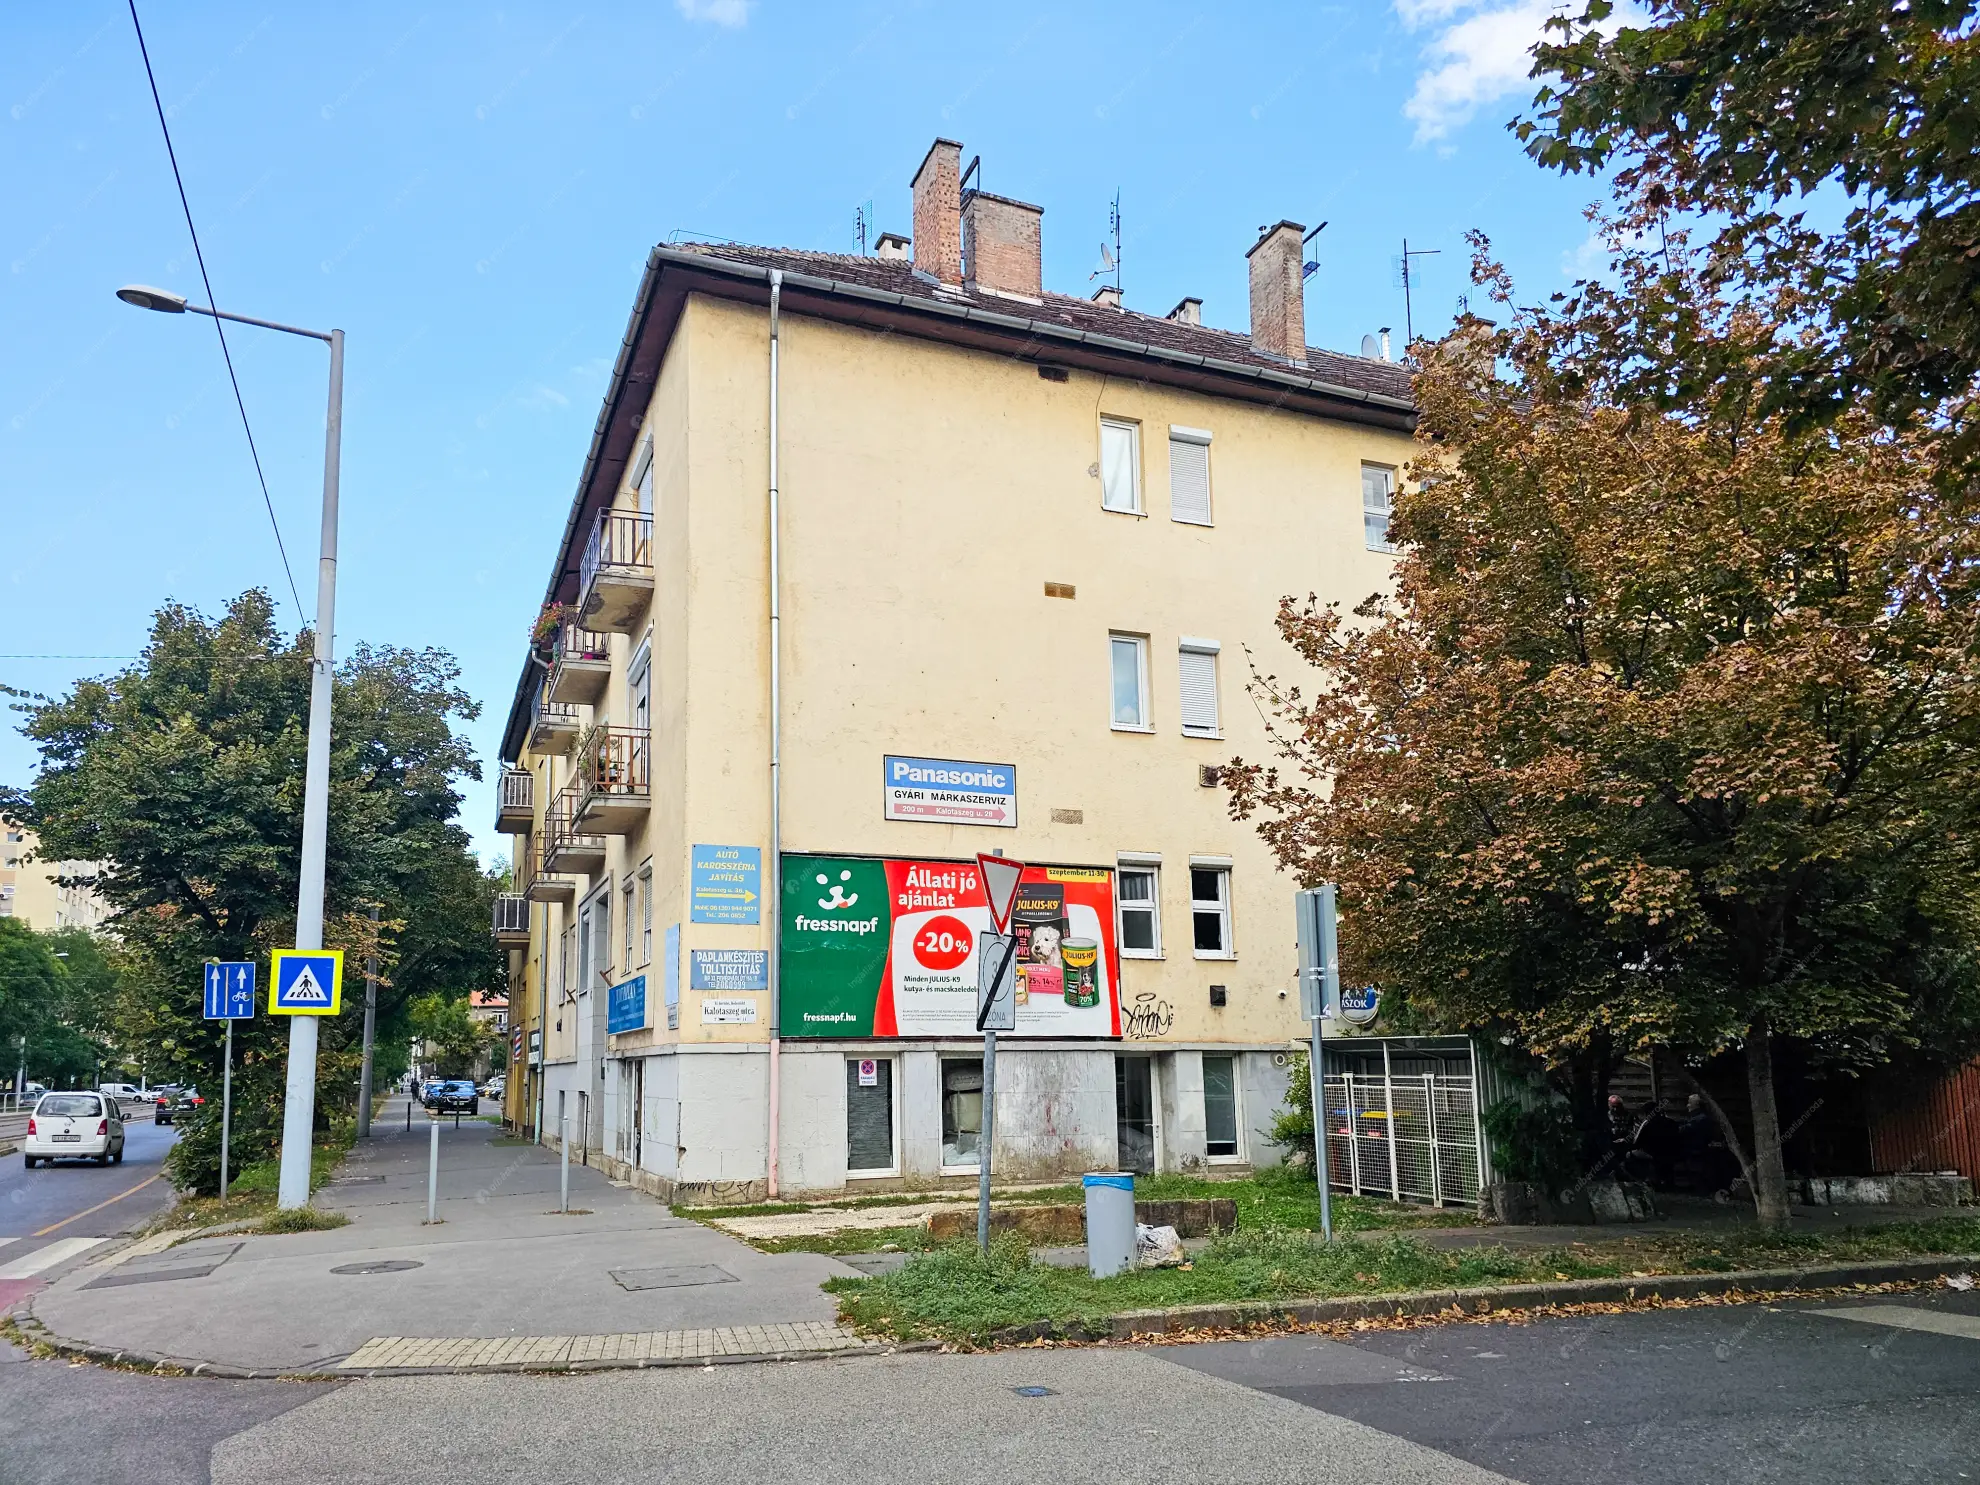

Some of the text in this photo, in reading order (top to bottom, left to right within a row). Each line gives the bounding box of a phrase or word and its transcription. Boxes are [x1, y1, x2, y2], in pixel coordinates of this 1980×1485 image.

[893, 761, 1006, 788] Panasonic
[894, 789, 1006, 805] GYÁRI MÁRKASZERVIZ
[902, 805, 915, 813] 200
[936, 807, 974, 817] Kalotaszeg
[715, 850, 739, 859] AUTÓ
[697, 861, 756, 871] KAROSSZÉRIA
[708, 872, 745, 882] JAVÍTÁS
[1049, 869, 1087, 877] szeptember
[905, 865, 977, 895] Állati jó
[898, 890, 955, 910] ajánlat
[1016, 900, 1058, 911] JULIUS-K9
[795, 915, 879, 936] fressnapf
[696, 950, 764, 963] PAPLANKÉSZÍTÉS
[700, 962, 761, 975] TOLLTISZTÍTÁS
[929, 976, 961, 984] JULIUS-K9
[903, 984, 925, 994] kutya-
[704, 1006, 739, 1017] Kalotaszeg
[803, 1012, 857, 1024] fressnapf.hu
